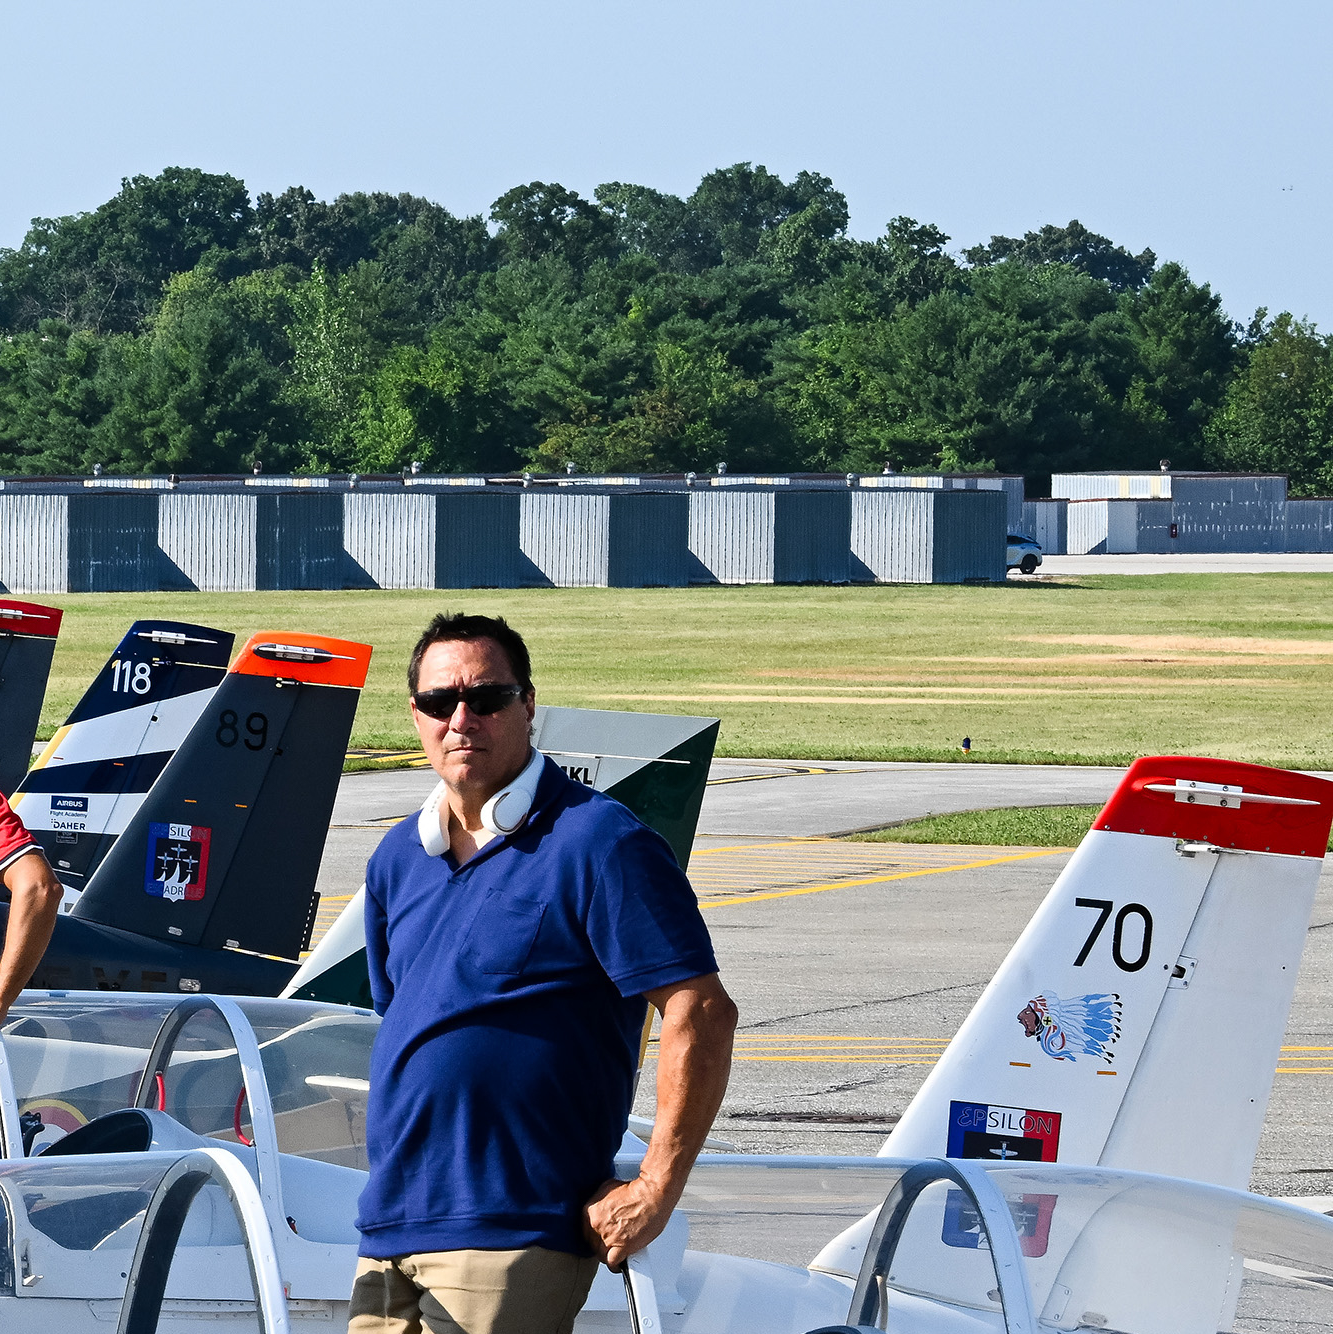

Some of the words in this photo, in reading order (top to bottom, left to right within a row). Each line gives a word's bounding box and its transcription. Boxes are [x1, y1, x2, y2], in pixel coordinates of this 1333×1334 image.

[112, 659, 151, 695] 118
[216, 709, 269, 751] 89
[56, 799, 84, 808] AIRBUS
[53, 821, 86, 831] DAHER
[1073, 897, 1153, 973] 70
[957, 1106, 1053, 1135] EPSILON
